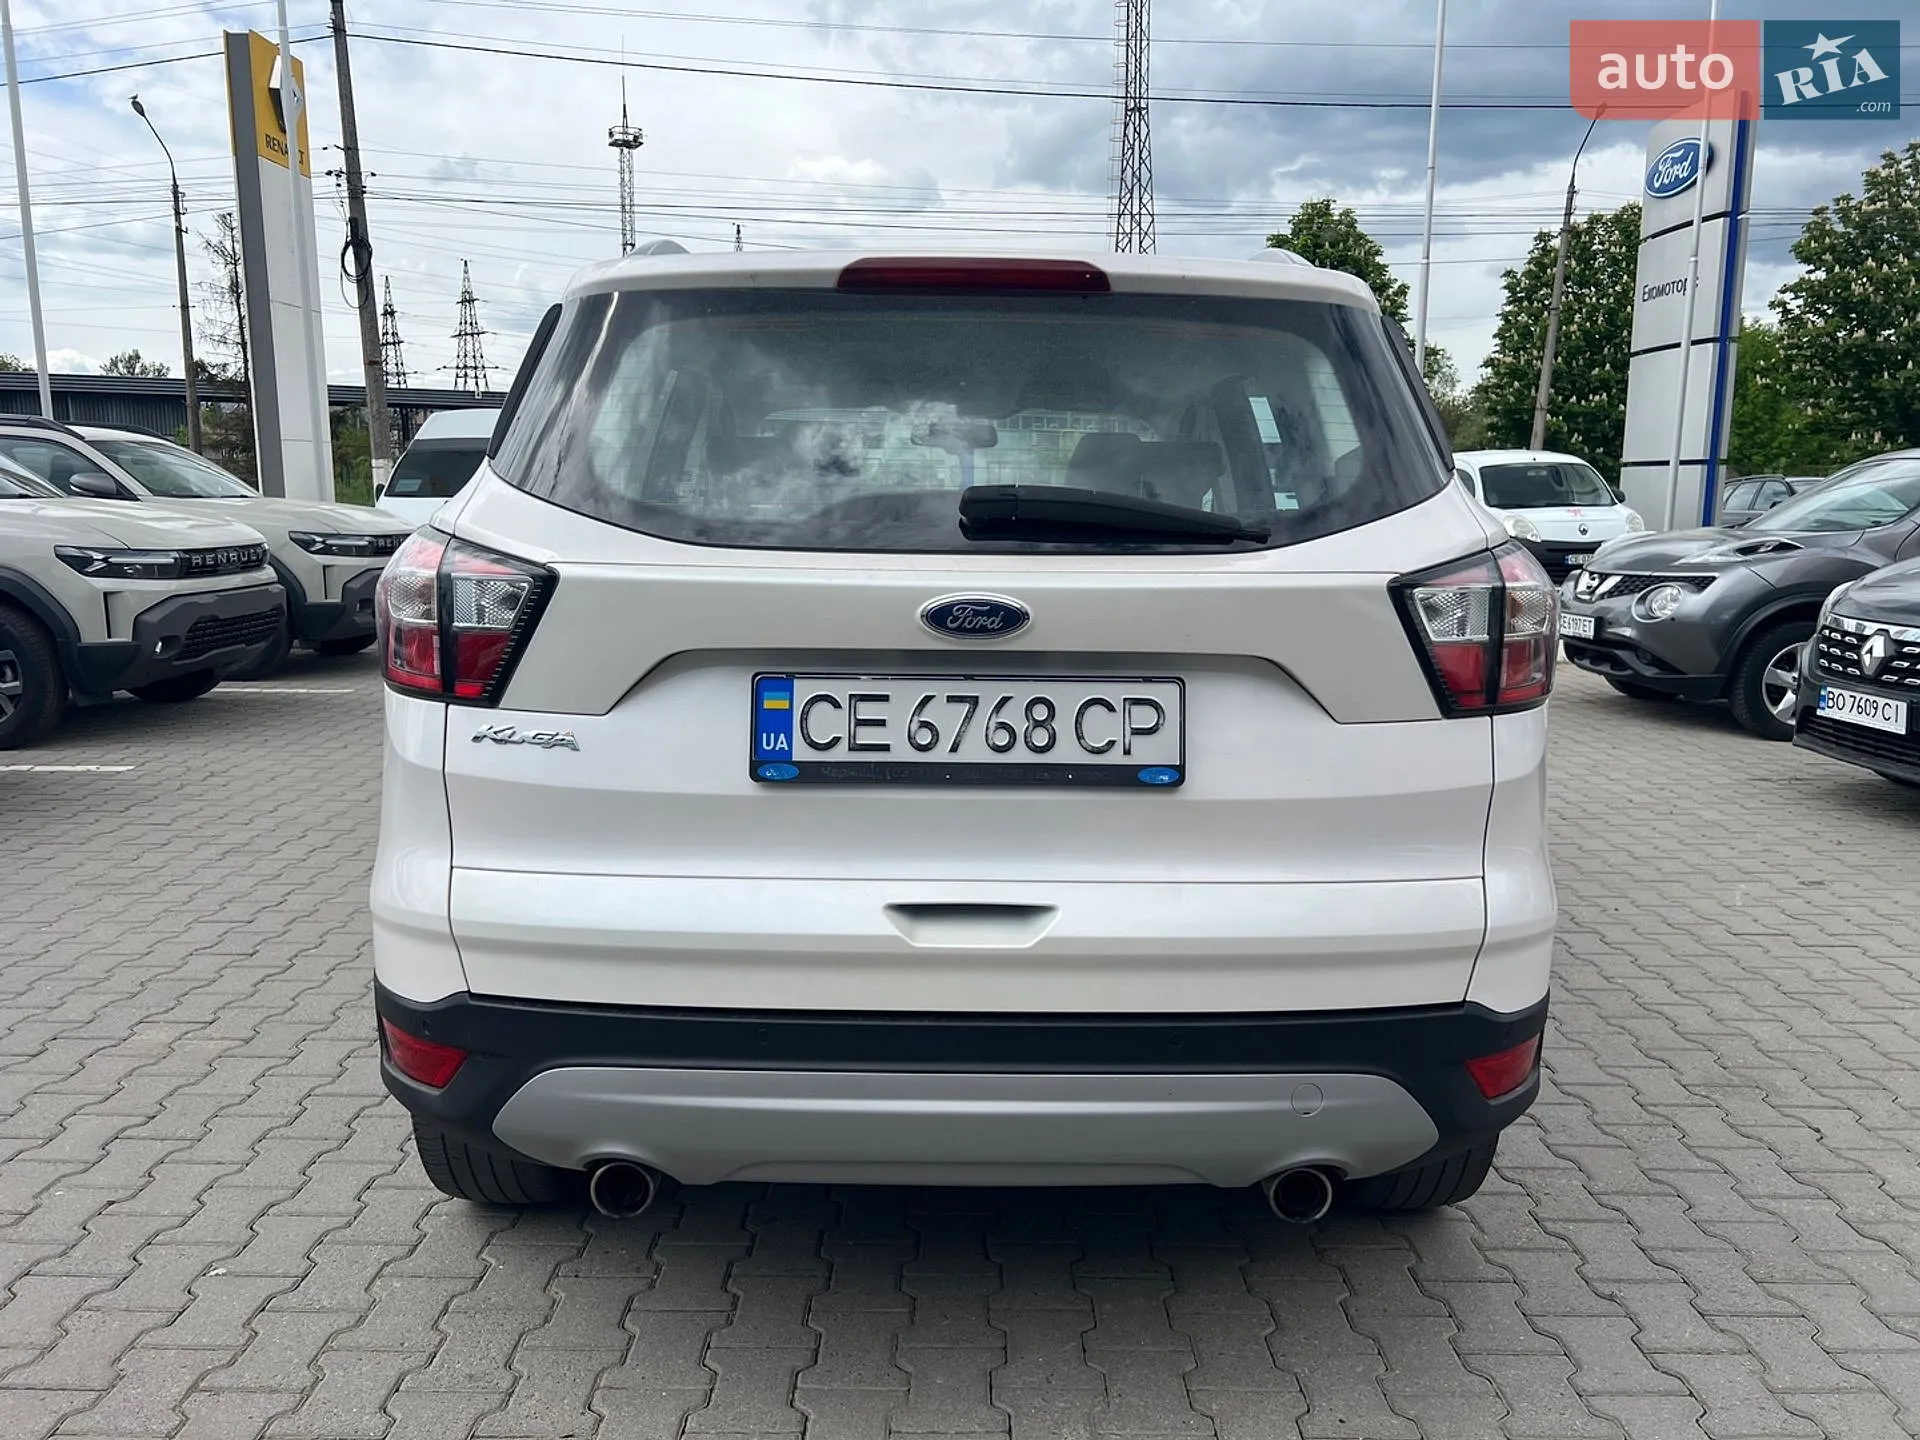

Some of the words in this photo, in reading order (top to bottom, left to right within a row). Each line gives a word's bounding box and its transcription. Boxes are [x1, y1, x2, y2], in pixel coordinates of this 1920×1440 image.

[1654, 149, 1692, 188] Ford
[947, 604, 1004, 629] Ford
[1583, 618, 1593, 633] ET
[1827, 691, 1846, 711] BO
[1849, 695, 1879, 719] 7609
[1882, 703, 1899, 723] CI
[798, 693, 891, 752] CE
[906, 694, 1058, 754] 6768
[1074, 696, 1166, 757] CP
[762, 733, 788, 750] UA
